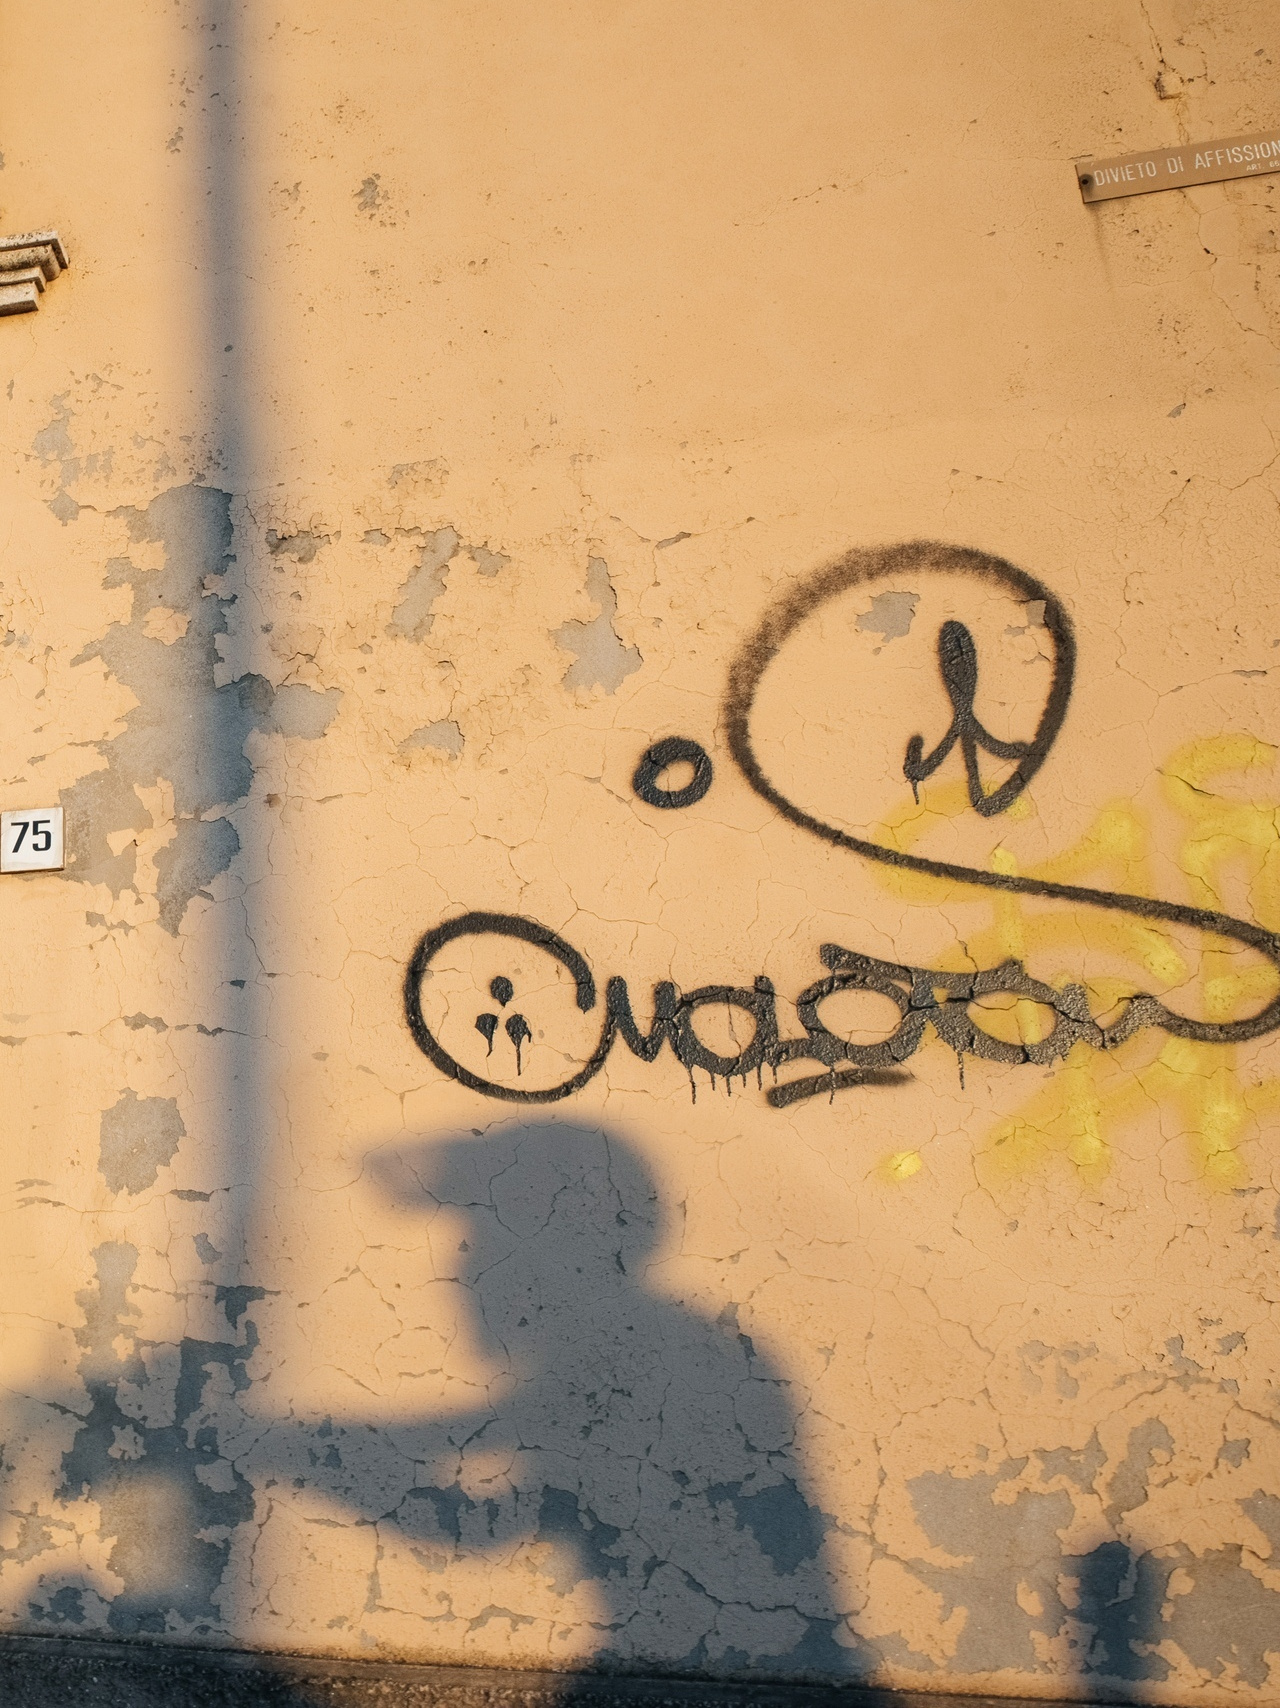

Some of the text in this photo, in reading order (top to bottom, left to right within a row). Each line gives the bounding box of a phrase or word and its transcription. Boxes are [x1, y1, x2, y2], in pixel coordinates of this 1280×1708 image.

[1094, 161, 1157, 186] DIVIETO
[1167, 156, 1184, 174] DI
[11, 819, 52, 853] 75
